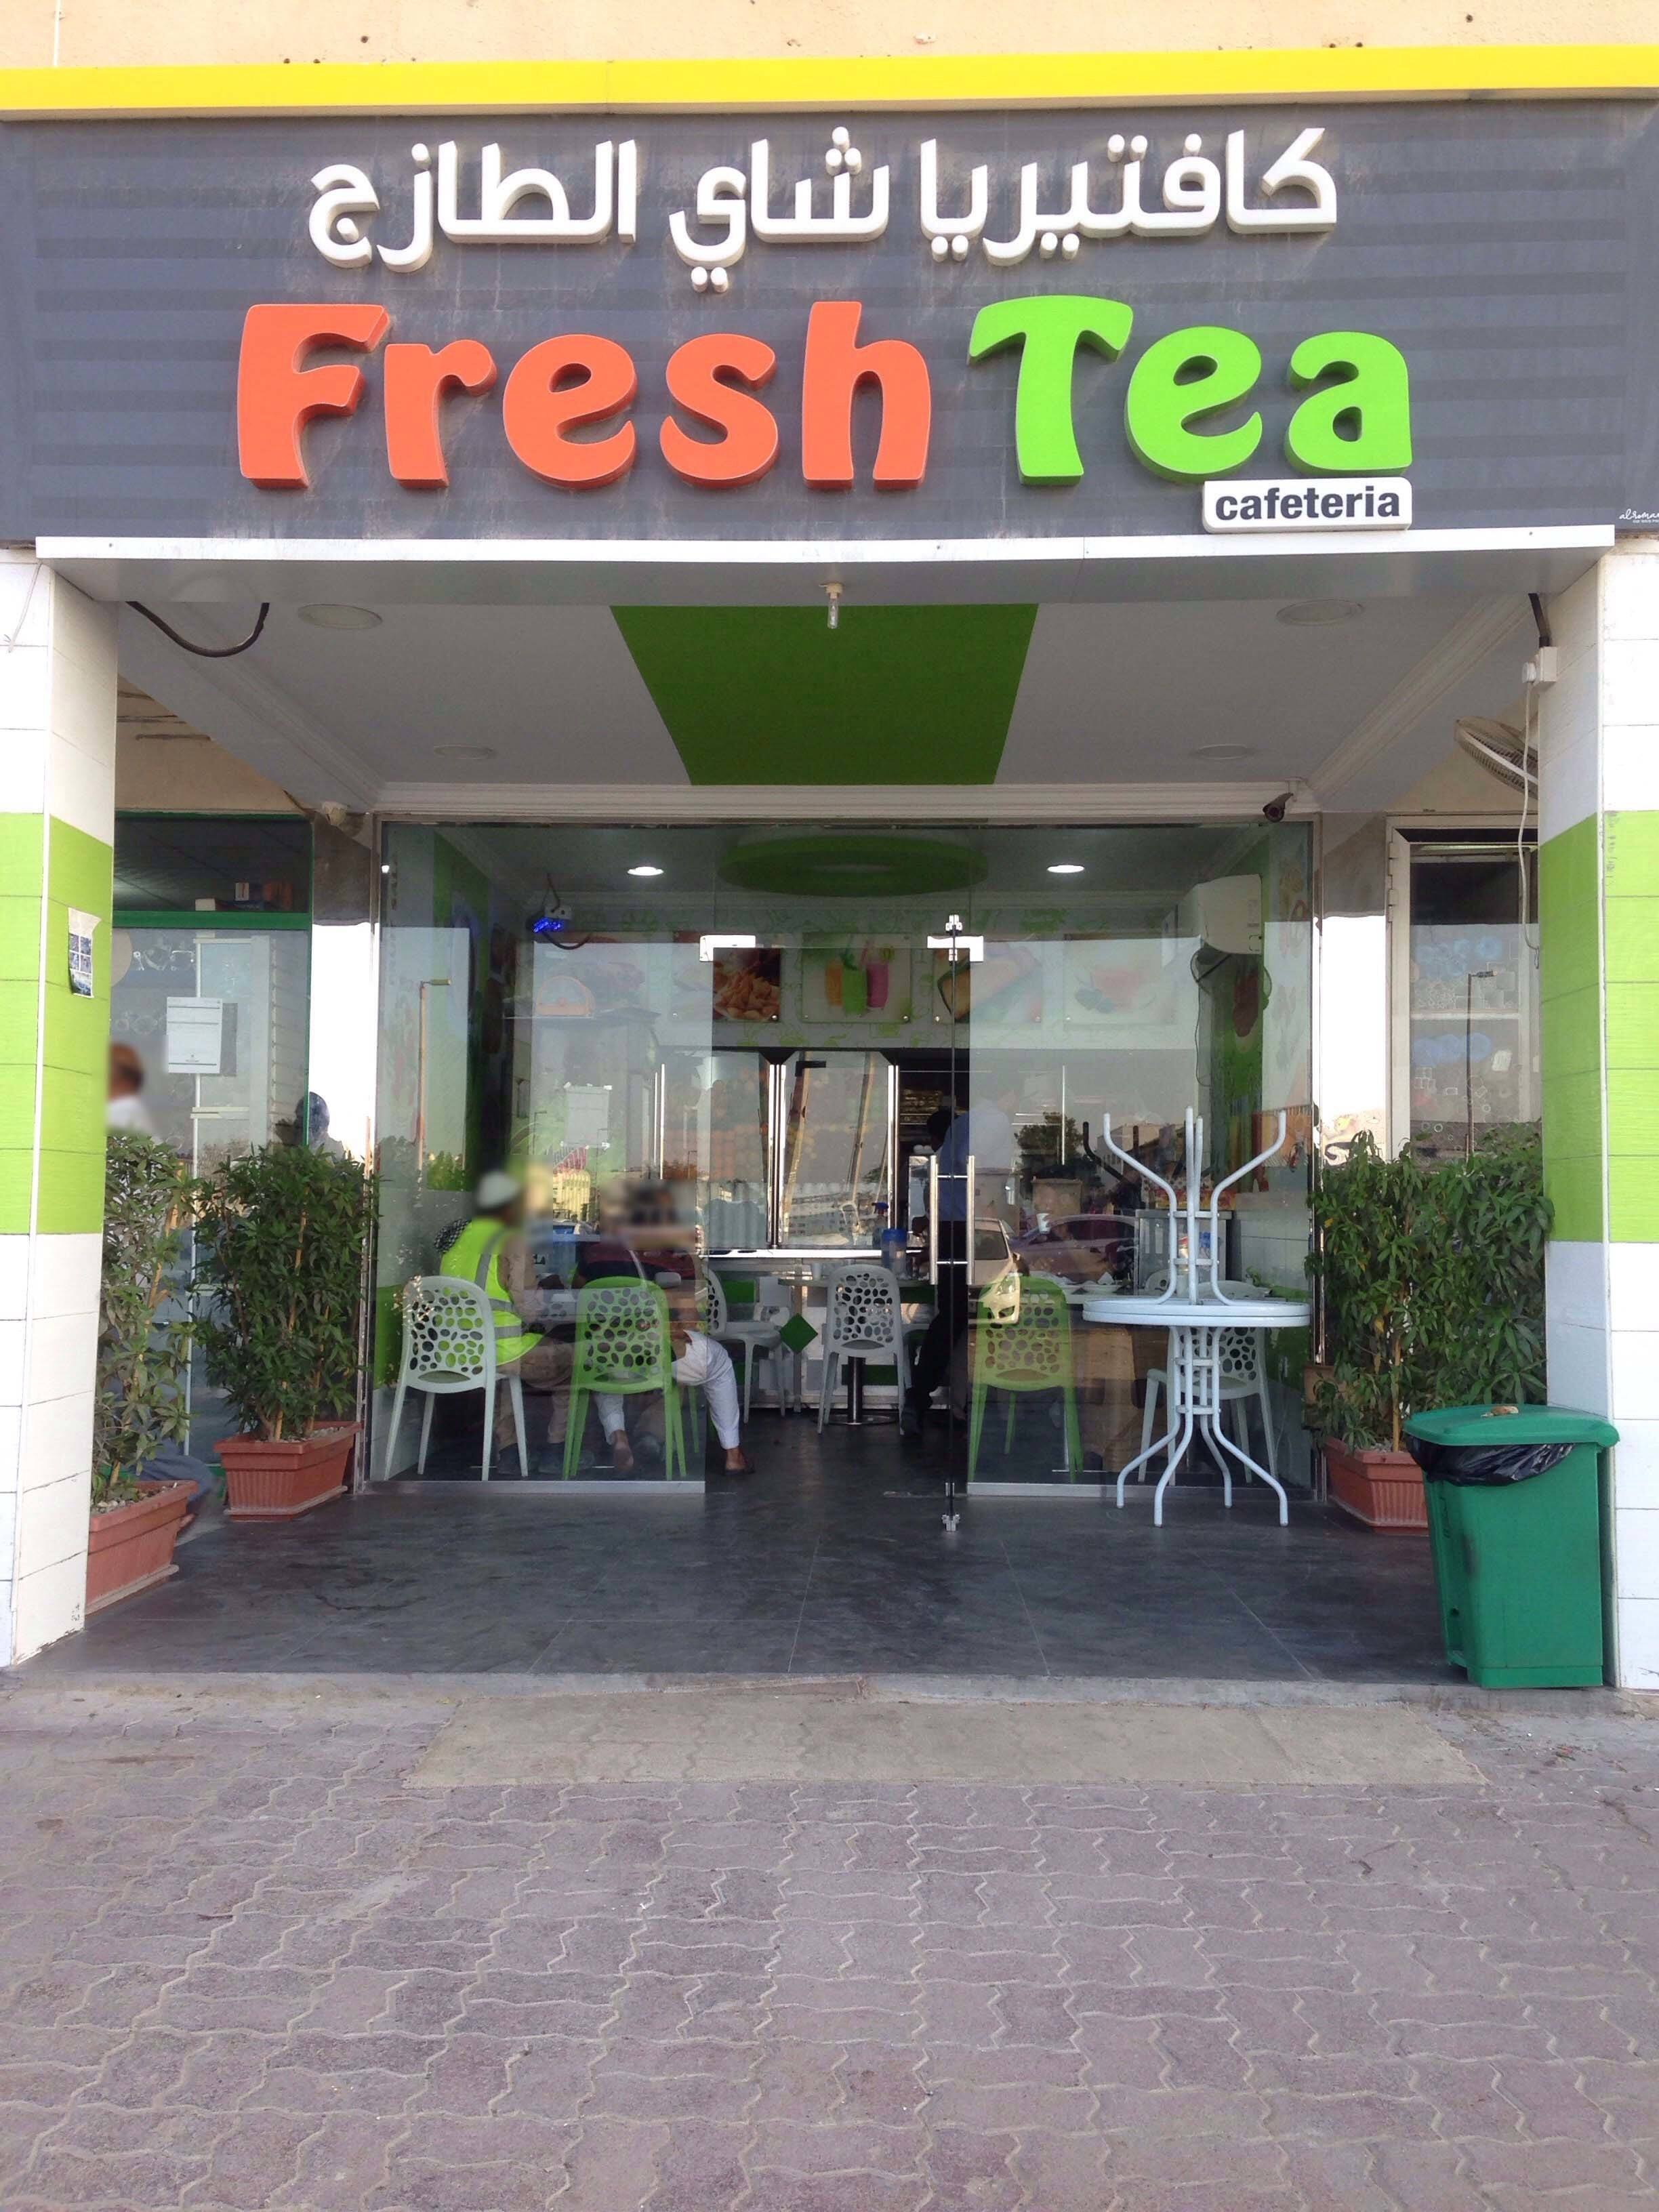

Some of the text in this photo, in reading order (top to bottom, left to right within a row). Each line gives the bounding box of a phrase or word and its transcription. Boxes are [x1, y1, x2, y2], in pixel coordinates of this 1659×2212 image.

[308, 126, 1338, 294] كافتيريا شاي الطازج
[237, 294, 1413, 491] Fresh Tea
[1214, 486, 1400, 521] cafeteria
